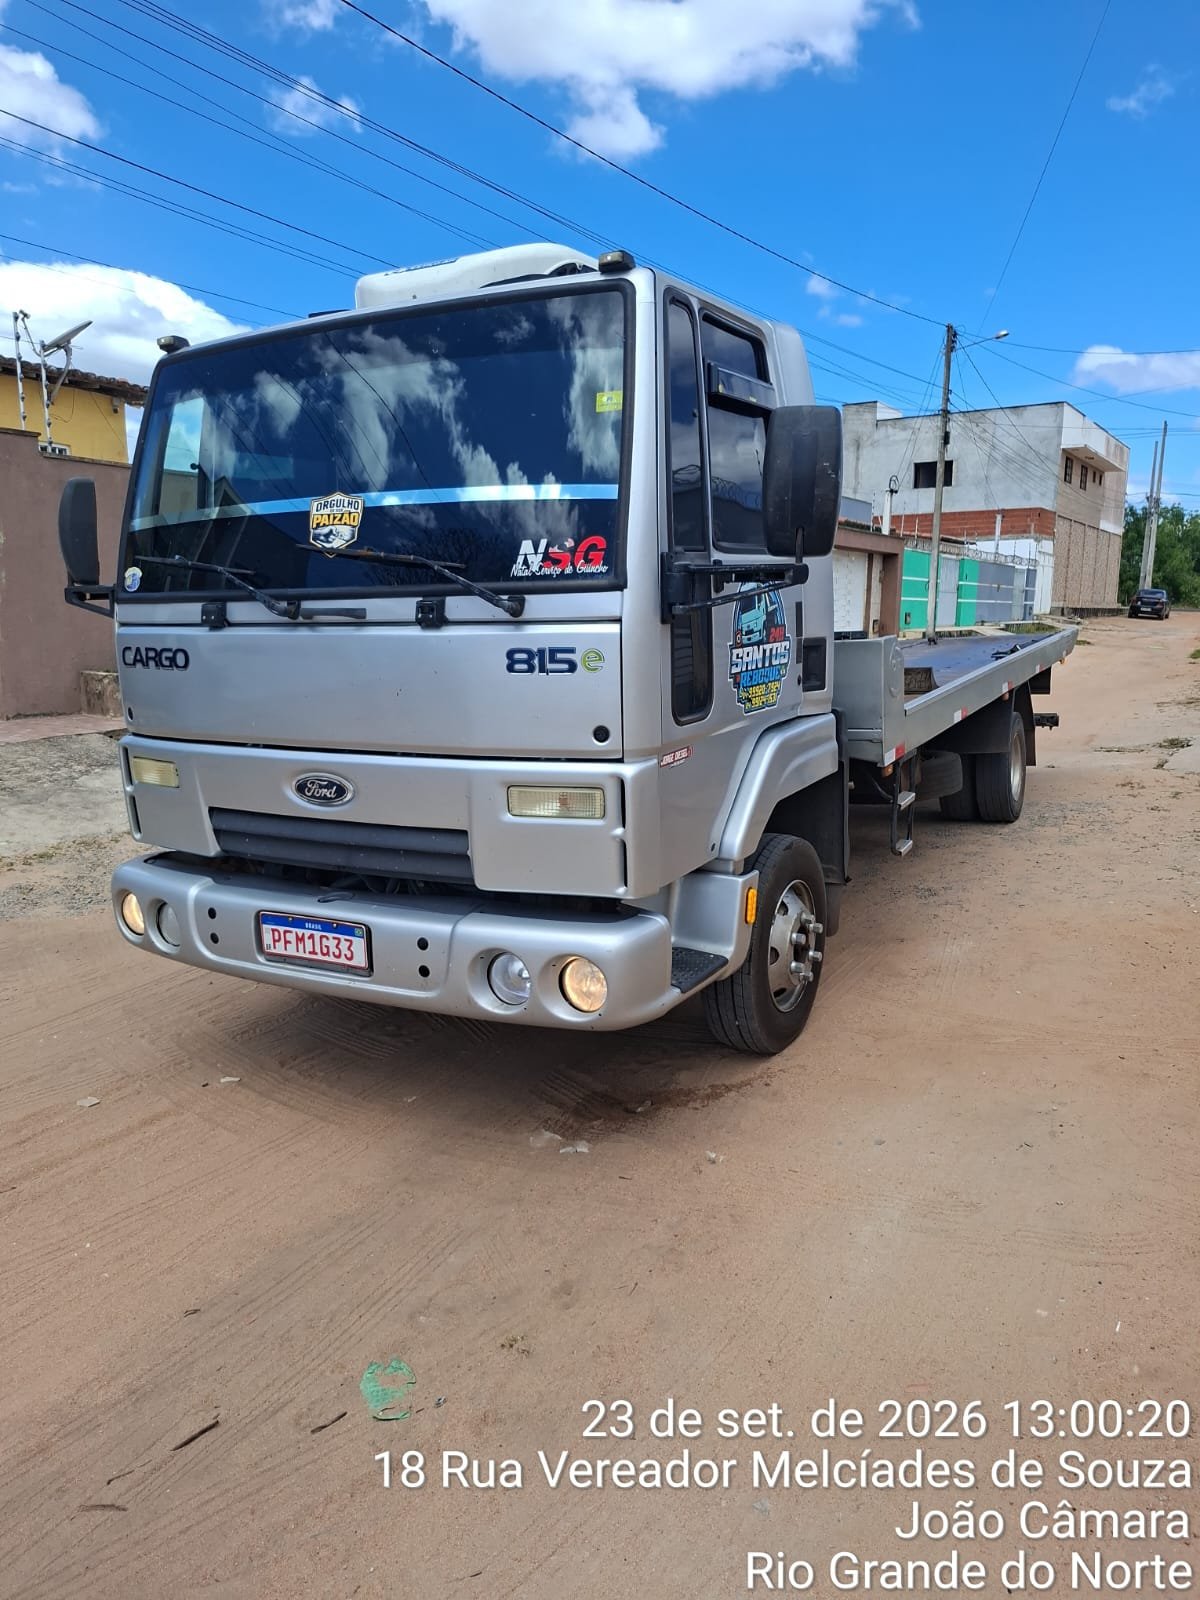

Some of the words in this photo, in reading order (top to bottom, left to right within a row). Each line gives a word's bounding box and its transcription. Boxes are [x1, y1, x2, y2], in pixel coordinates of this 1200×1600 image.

[315, 498, 359, 512] ORGULHO
[312, 509, 360, 528] PAIZÃO
[515, 536, 607, 572] NSG
[122, 646, 190, 670] CARGO
[731, 641, 790, 674] SANTOS
[740, 665, 782, 688] REBOQUE
[304, 779, 337, 799] Ford
[305, 922, 323, 931] BRASIL
[270, 927, 355, 962] PFM1G33
